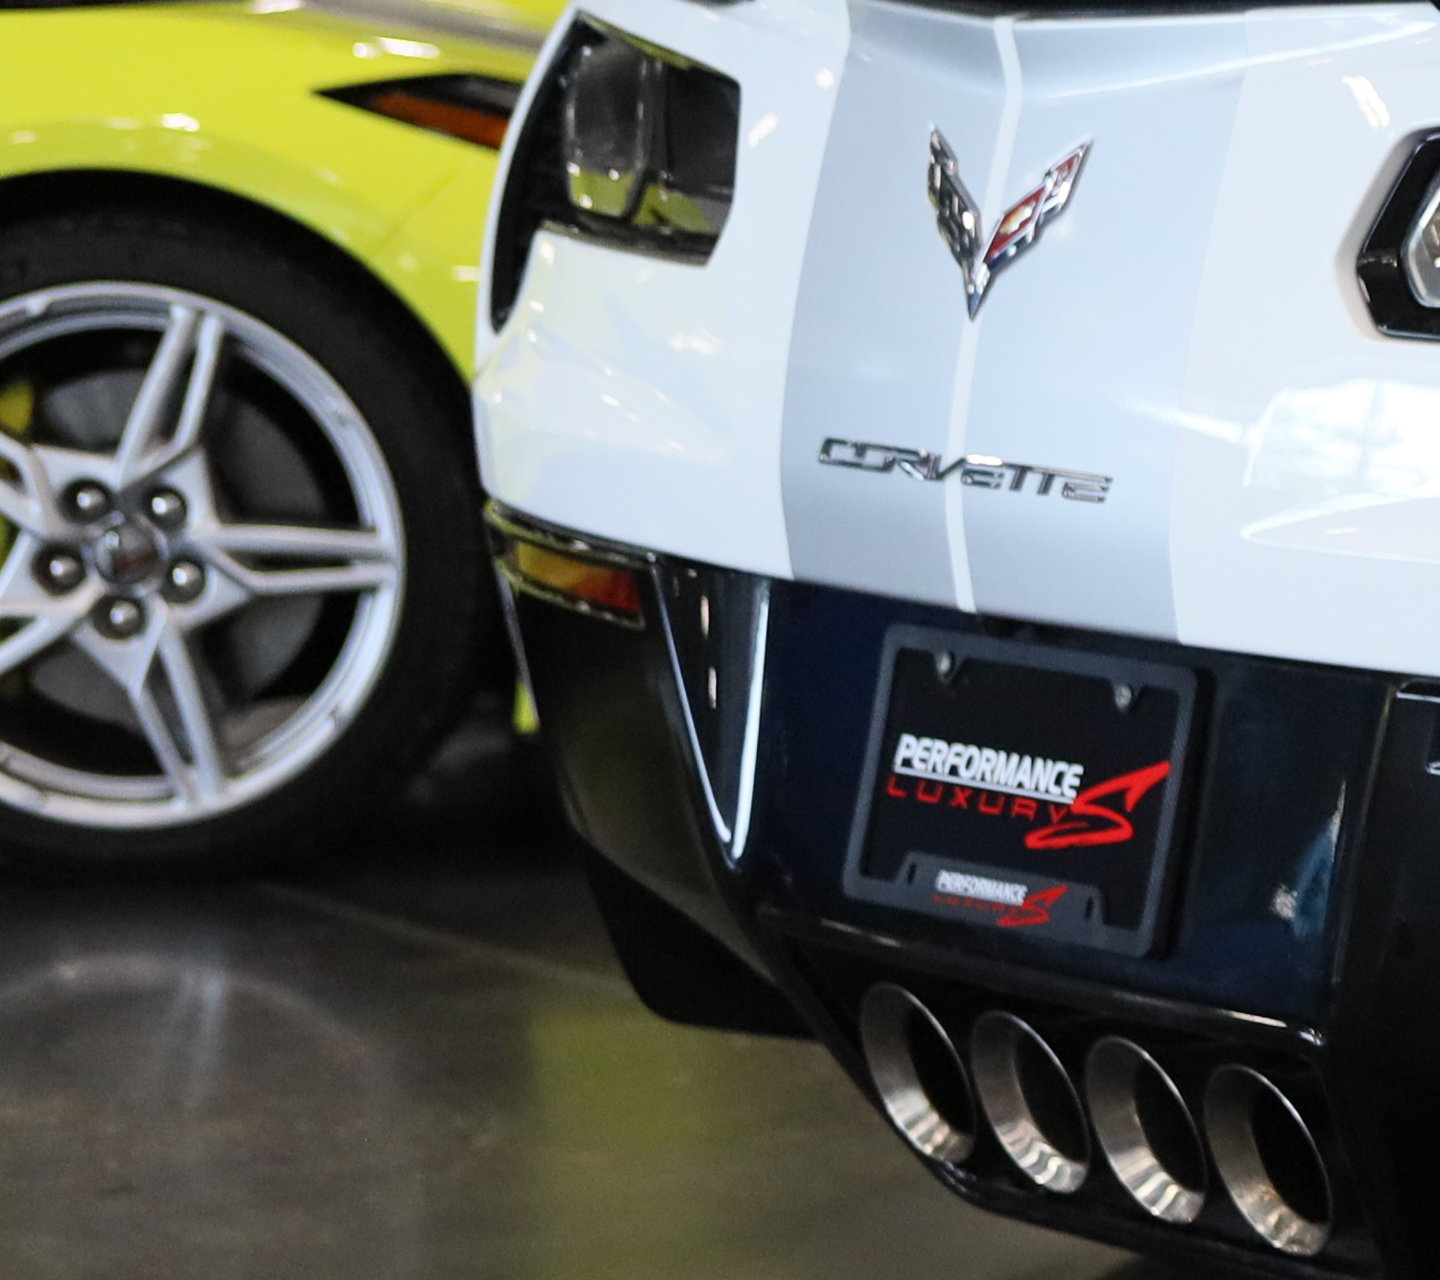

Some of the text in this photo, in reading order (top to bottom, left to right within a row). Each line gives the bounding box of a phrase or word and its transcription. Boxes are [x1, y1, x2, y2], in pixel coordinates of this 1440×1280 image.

[818, 436, 1113, 503] CORVETTE
[894, 732, 1084, 800] PERFORMANCE
[886, 775, 1070, 824] LUXURY
[935, 869, 1028, 906] PERFORMANCE
